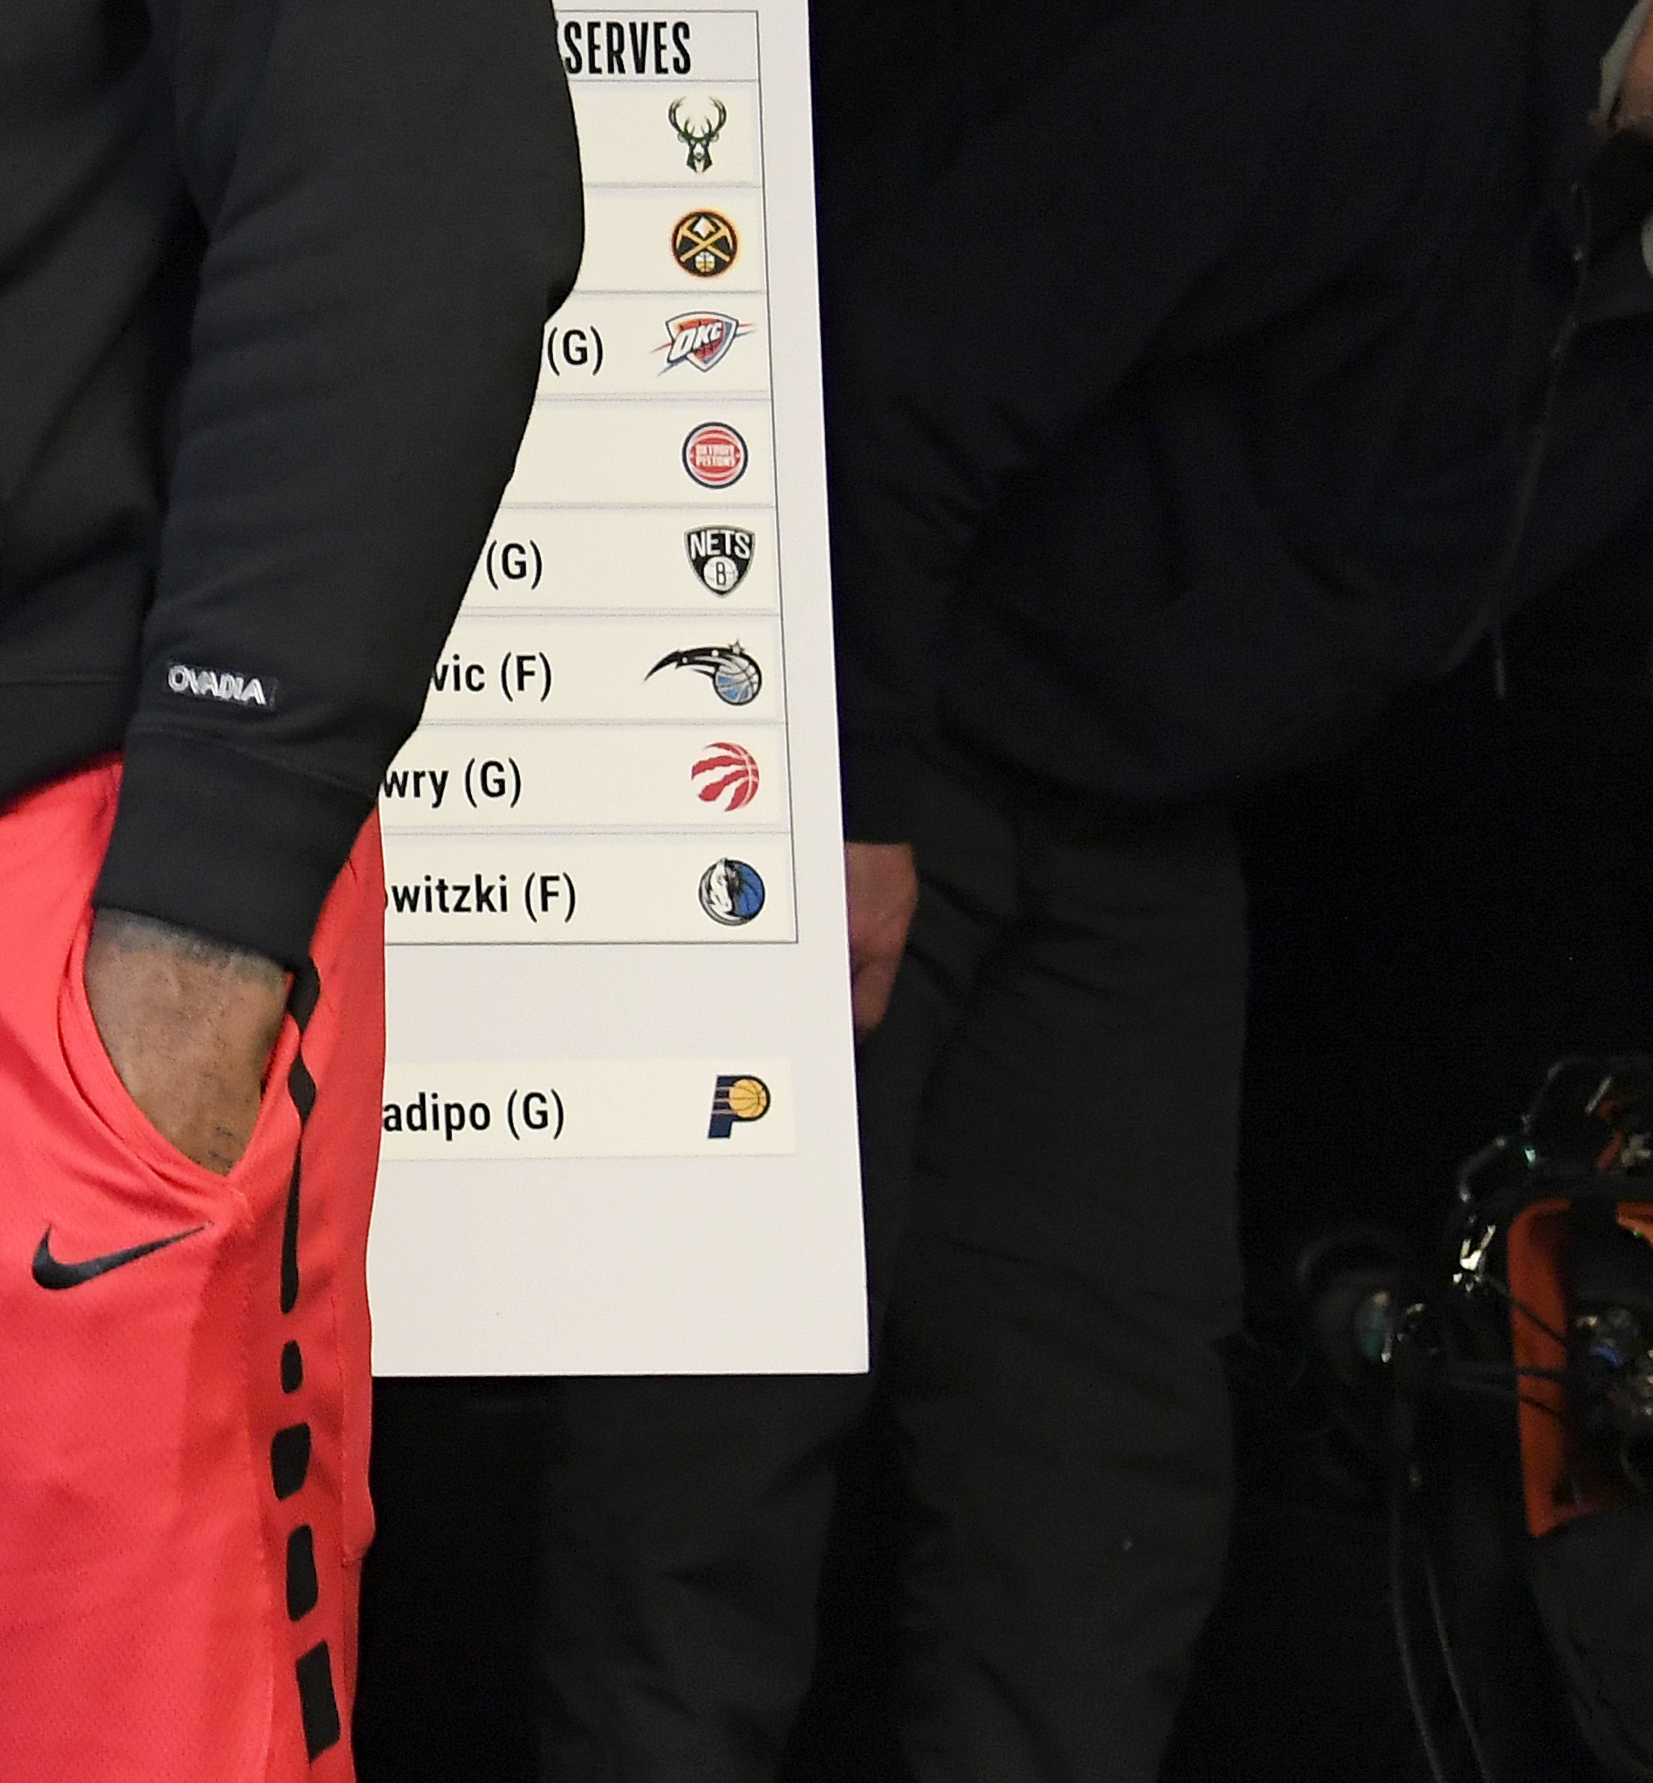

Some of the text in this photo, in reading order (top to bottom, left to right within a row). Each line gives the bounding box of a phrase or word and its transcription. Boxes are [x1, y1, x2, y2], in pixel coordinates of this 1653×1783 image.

[555, 20, 692, 75] SERVES
[547, 325, 604, 376] (G)
[668, 322, 723, 362] OKC
[486, 540, 543, 591] (G)
[690, 529, 751, 561] NETS
[715, 561, 727, 586] B
[168, 665, 267, 705] OVADIA
[500, 651, 552, 702] (F)
[465, 757, 522, 809] (G)
[384, 872, 576, 923] witzki (F)
[507, 1088, 564, 1141] (G)
